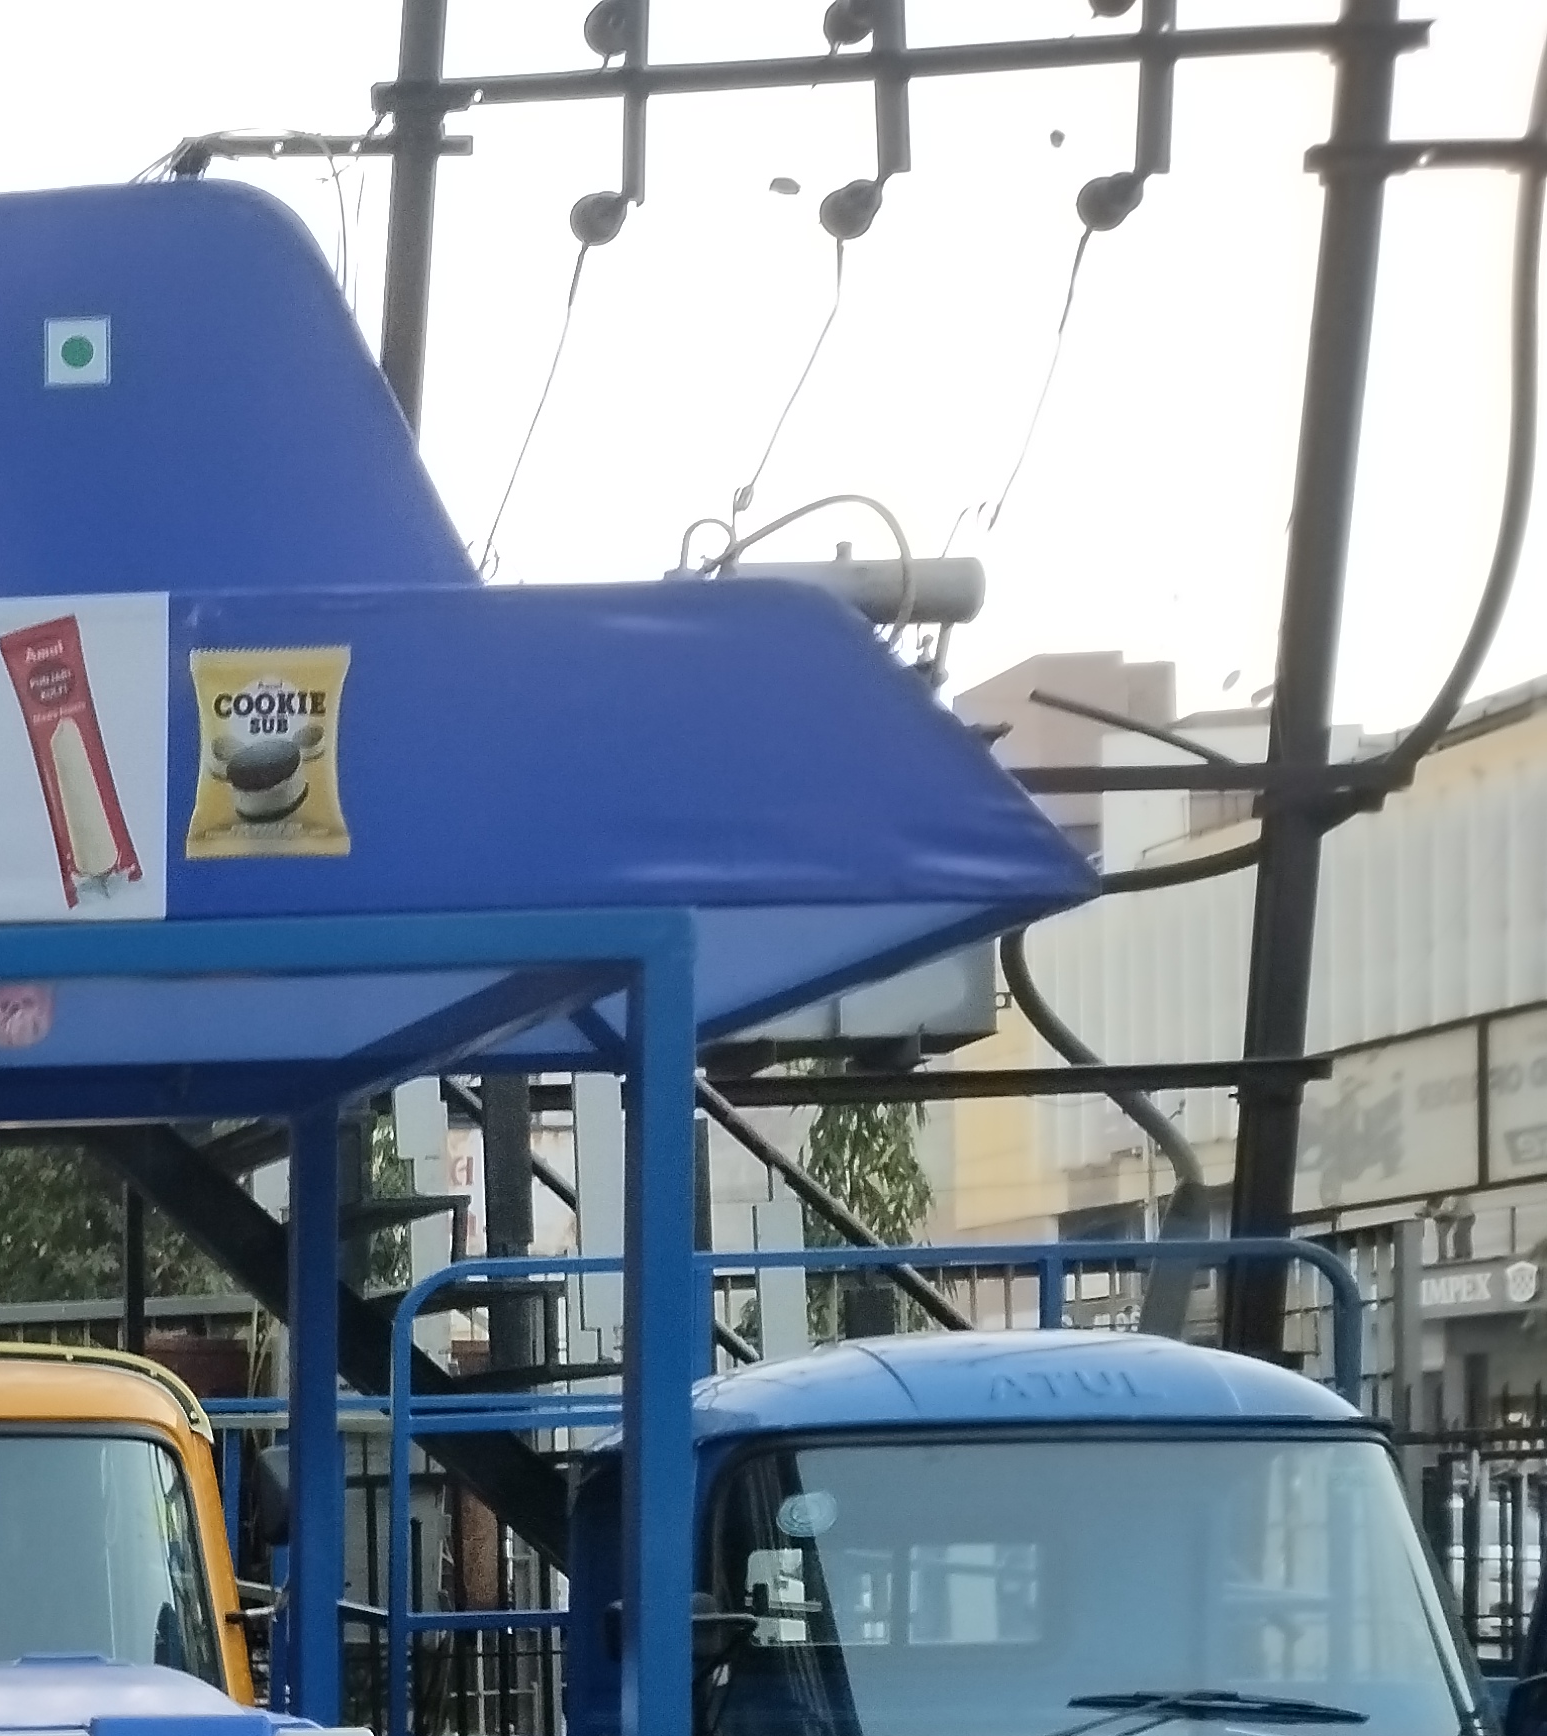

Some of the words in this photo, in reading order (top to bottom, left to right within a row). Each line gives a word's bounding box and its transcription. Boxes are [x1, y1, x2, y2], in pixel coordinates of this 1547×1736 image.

[213, 691, 327, 719] COOKIE
[249, 716, 289, 735] SUB
[989, 1367, 1163, 1402] ATUL
